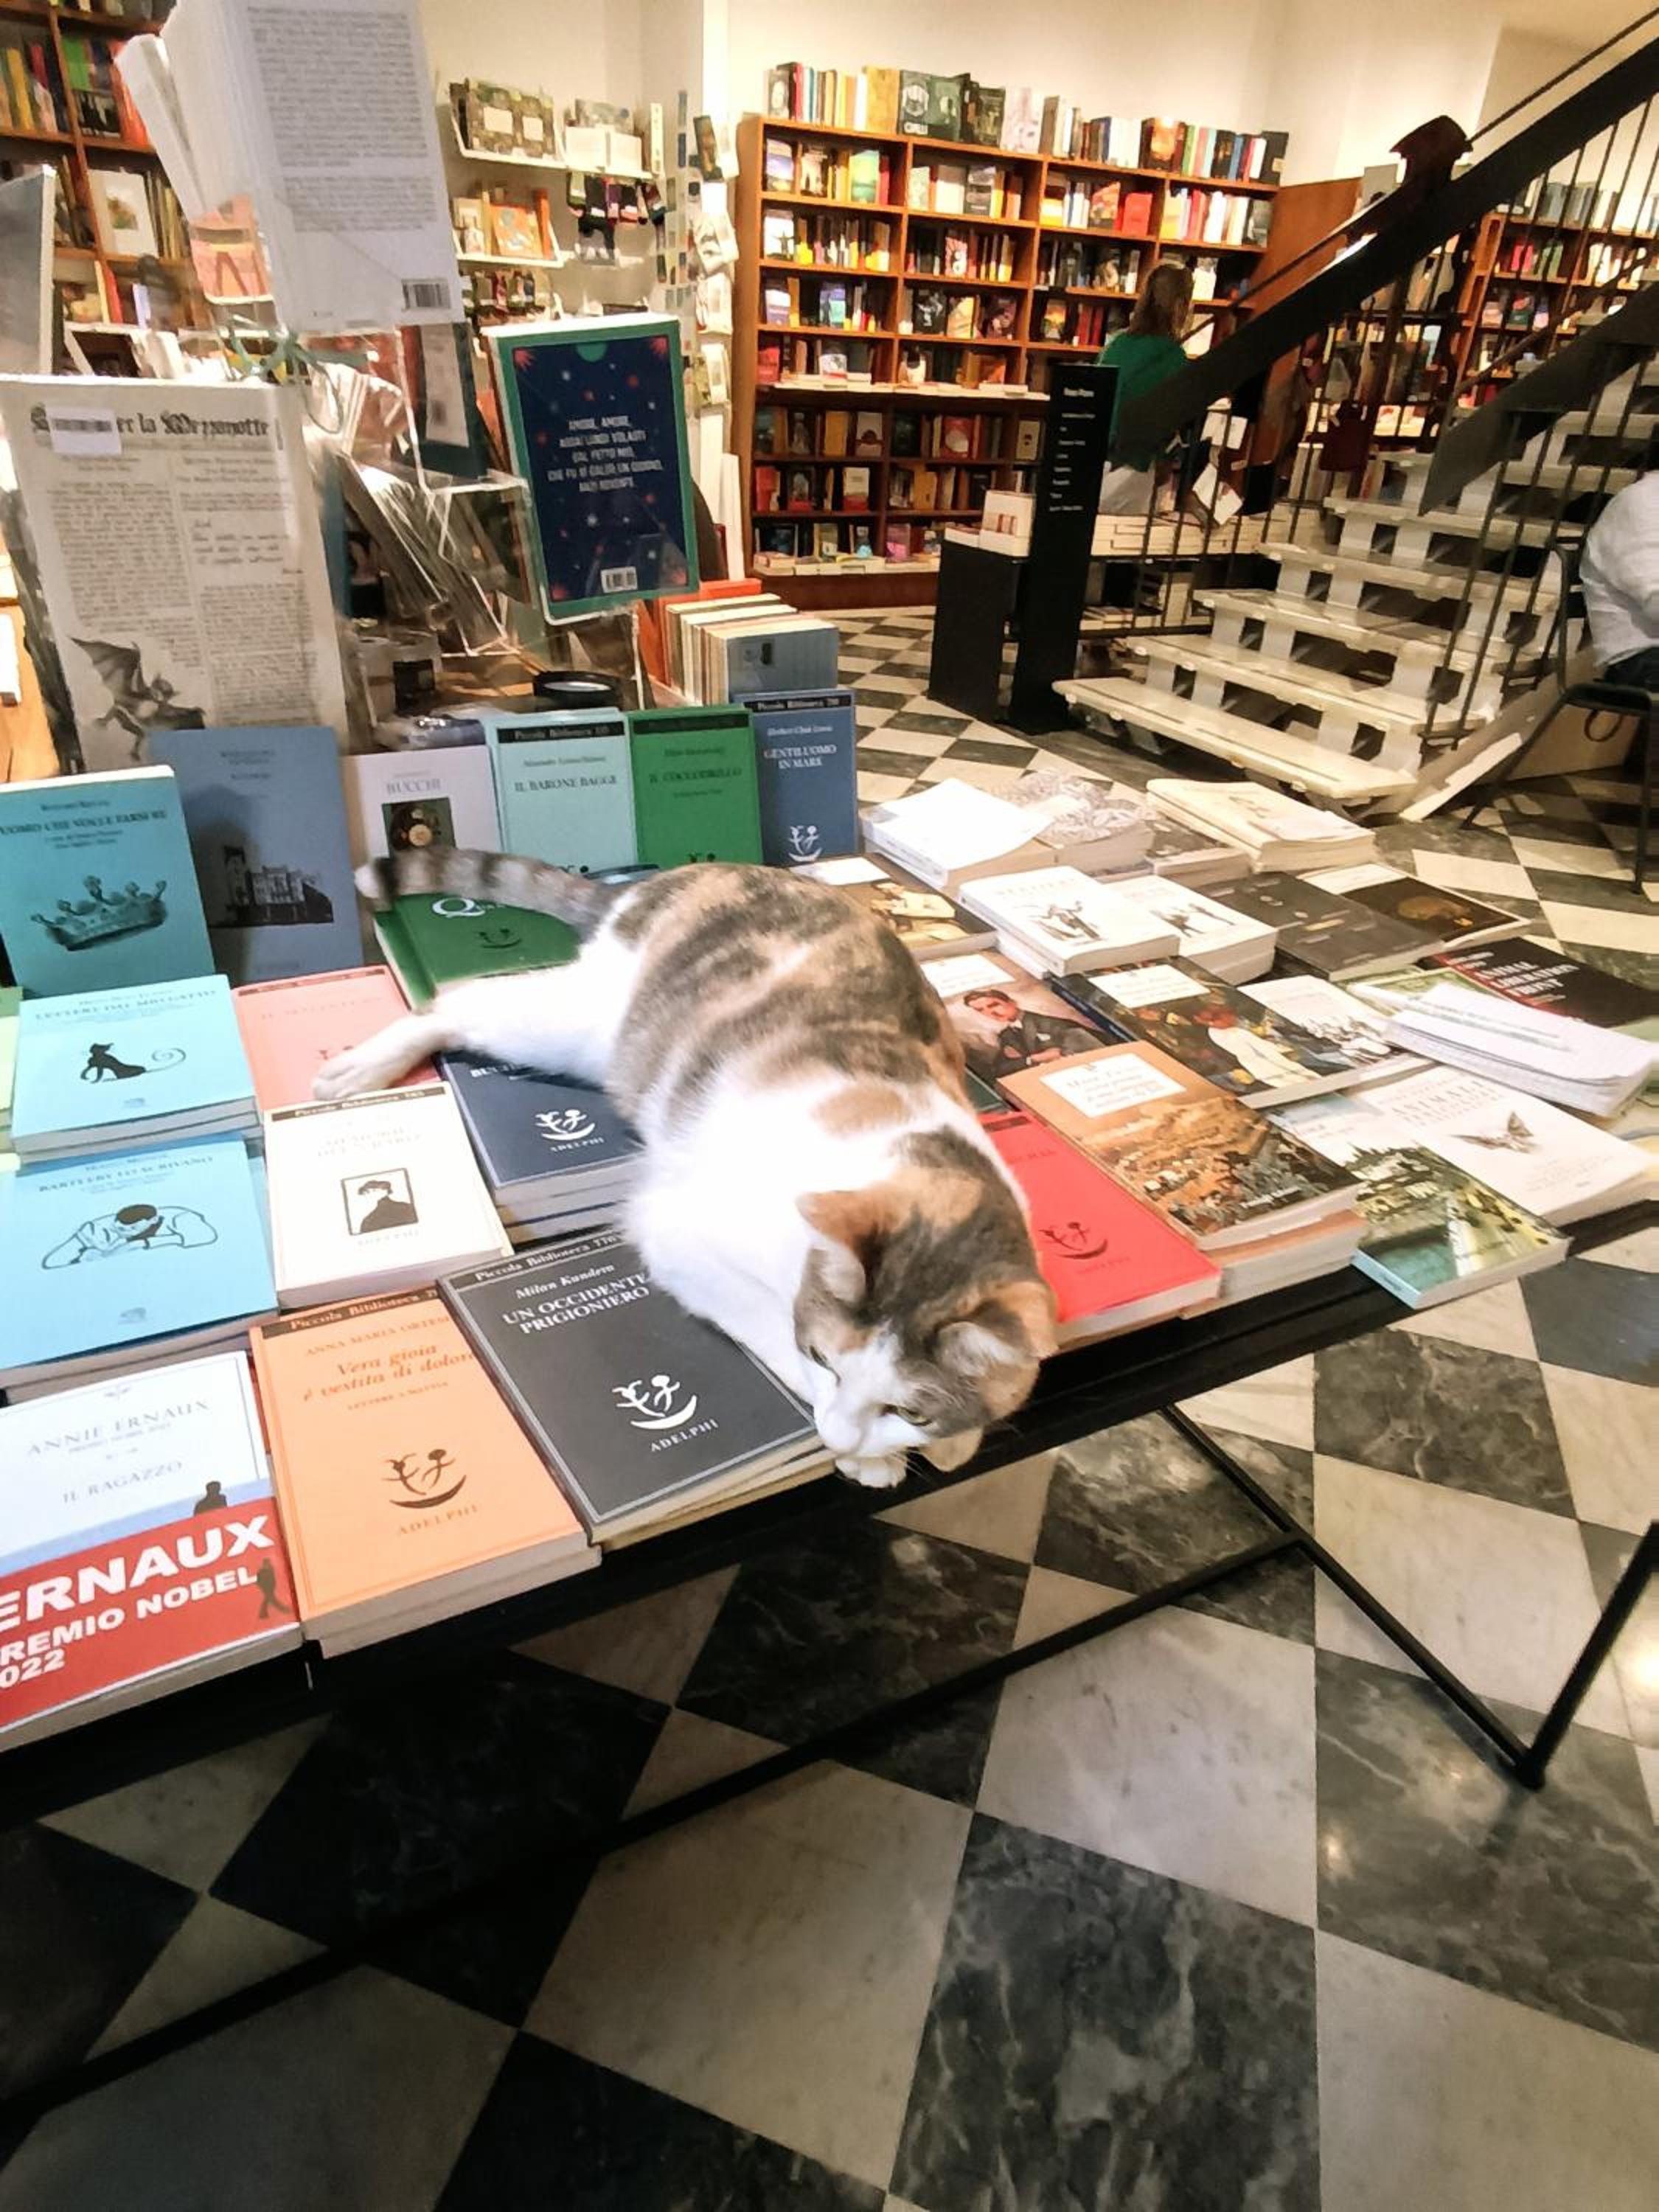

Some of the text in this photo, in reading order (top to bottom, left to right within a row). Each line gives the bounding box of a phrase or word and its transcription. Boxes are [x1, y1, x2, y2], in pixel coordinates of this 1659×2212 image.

[137, 411, 157, 434] la
[763, 743, 838, 759] GENTILUOMO
[778, 756, 824, 769] IN MARE
[514, 781, 526, 792] IL
[529, 777, 577, 791] BARONE
[549, 1136, 605, 1152] ADELPHI
[475, 1263, 524, 1281] Piccola
[526, 1243, 591, 1267] Biblioteca
[502, 1272, 651, 1325] UN OCCIDENTE
[515, 1263, 615, 1300] Milan Kundera
[290, 1312, 344, 1330] Piccola
[348, 1293, 422, 1317] Biblioteca
[519, 1286, 650, 1335] PRIGIONIERO
[305, 1340, 347, 1357] ANNA
[349, 1326, 397, 1346] MARIA
[336, 1343, 438, 1376] Vera gioia
[320, 1373, 387, 1397] vestita
[393, 1365, 414, 1380] di
[27, 1399, 211, 1458] ANNIE ERNAUX
[650, 1417, 720, 1453] ADELPHI
[63, 1460, 184, 1503] IL RAGAZZO
[397, 1503, 481, 1537] ADELPHI
[0, 1514, 276, 1634] ERNAUX
[0, 1565, 258, 1666] REMIO NOBEL
[0, 1648, 66, 1690] 022
